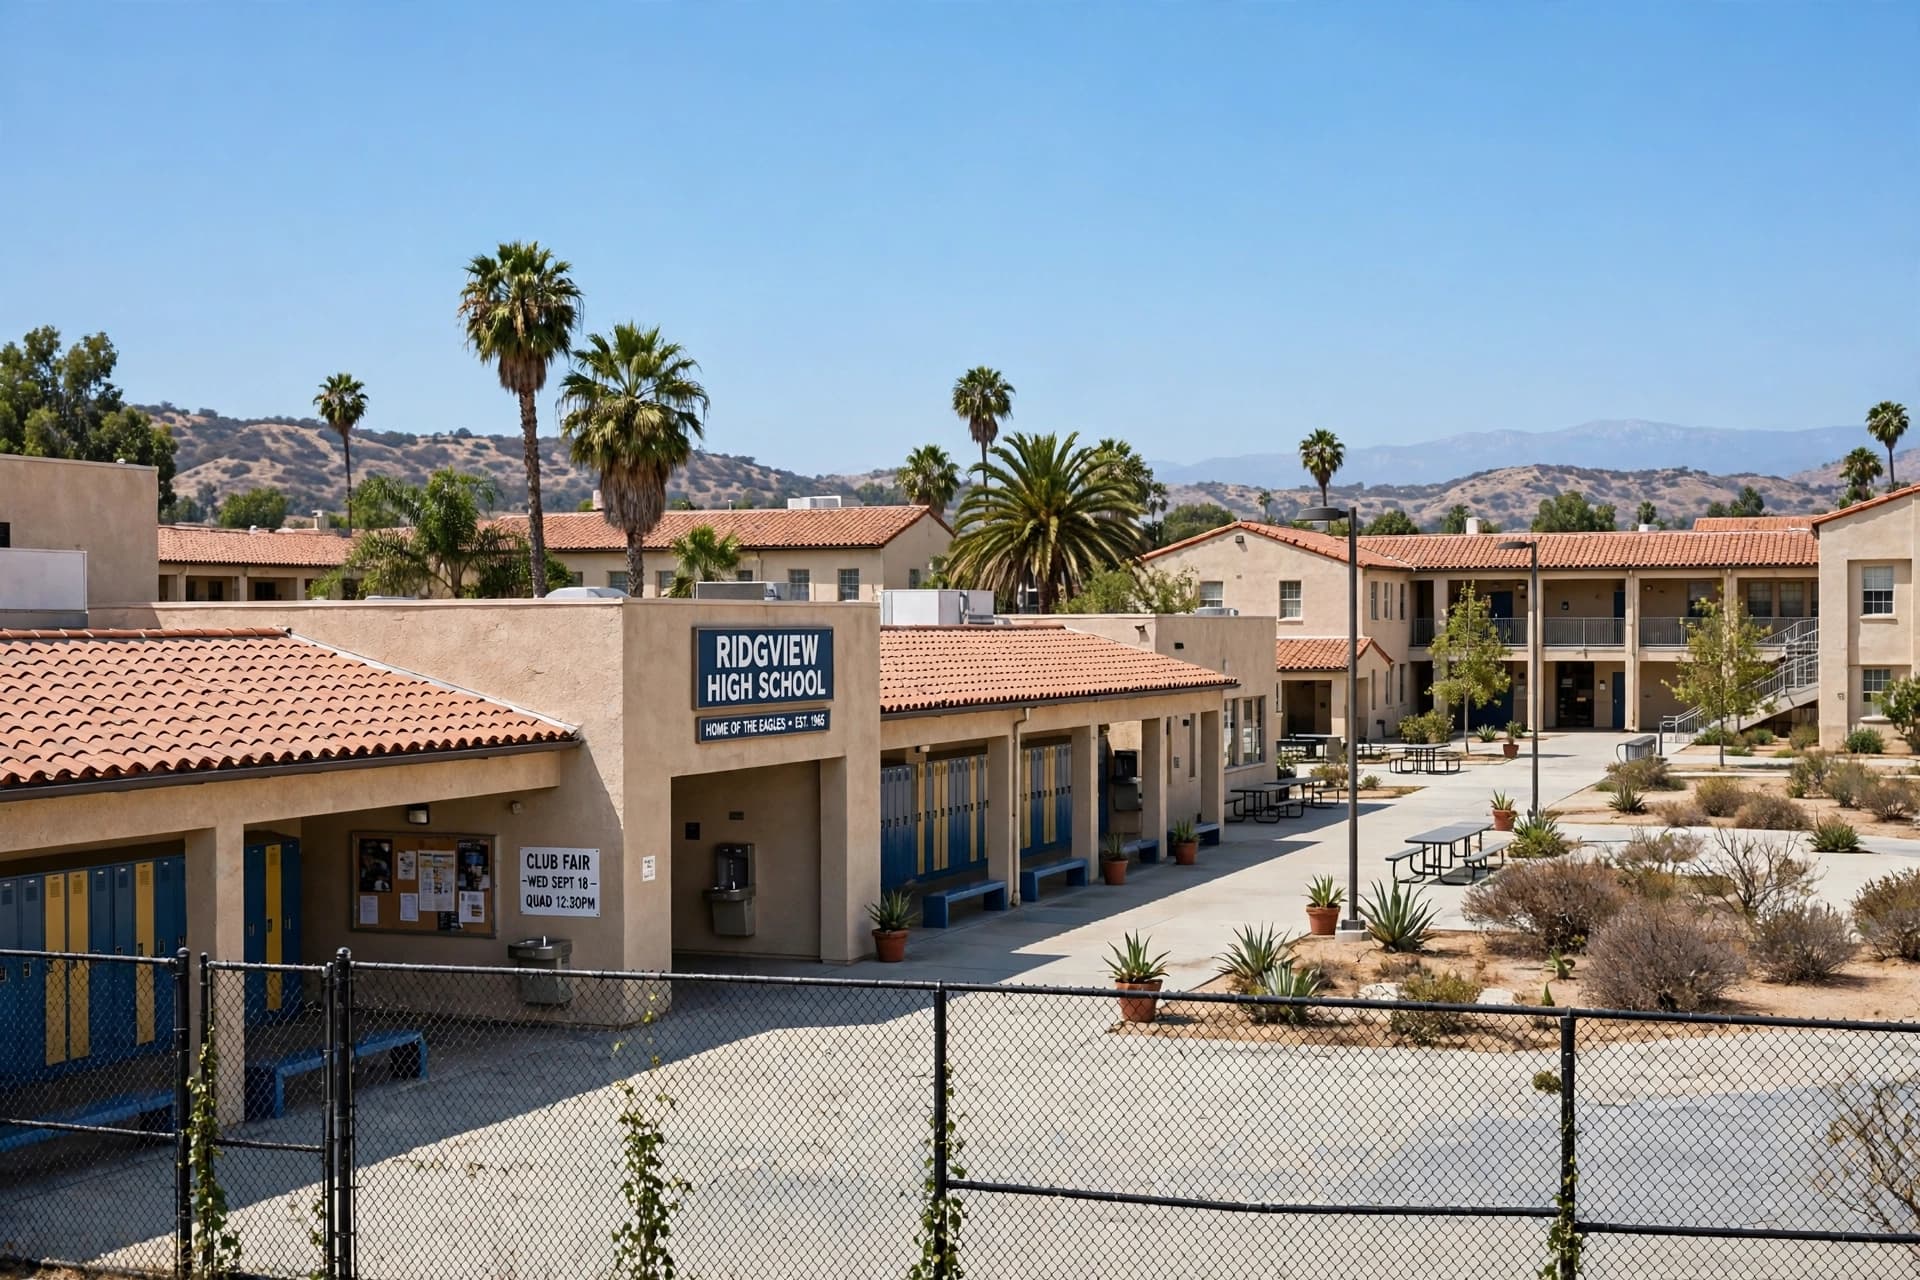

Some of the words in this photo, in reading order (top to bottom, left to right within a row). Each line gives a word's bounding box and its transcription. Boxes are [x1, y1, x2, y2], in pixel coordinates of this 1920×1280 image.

[716, 634, 819, 669] RIDGVIEW
[707, 673, 753, 702] HIGH
[758, 669, 826, 699] SCHOOL
[705, 722, 729, 737] HOME
[730, 721, 741, 734] OF
[743, 719, 758, 733] THE
[758, 717, 786, 732] EAGLES
[526, 853, 558, 870] CLUB
[563, 854, 590, 871] FAIR
[551, 876, 575, 889] SEPT
[526, 894, 553, 909] QUAD
[556, 895, 595, 910] 12:30PM
